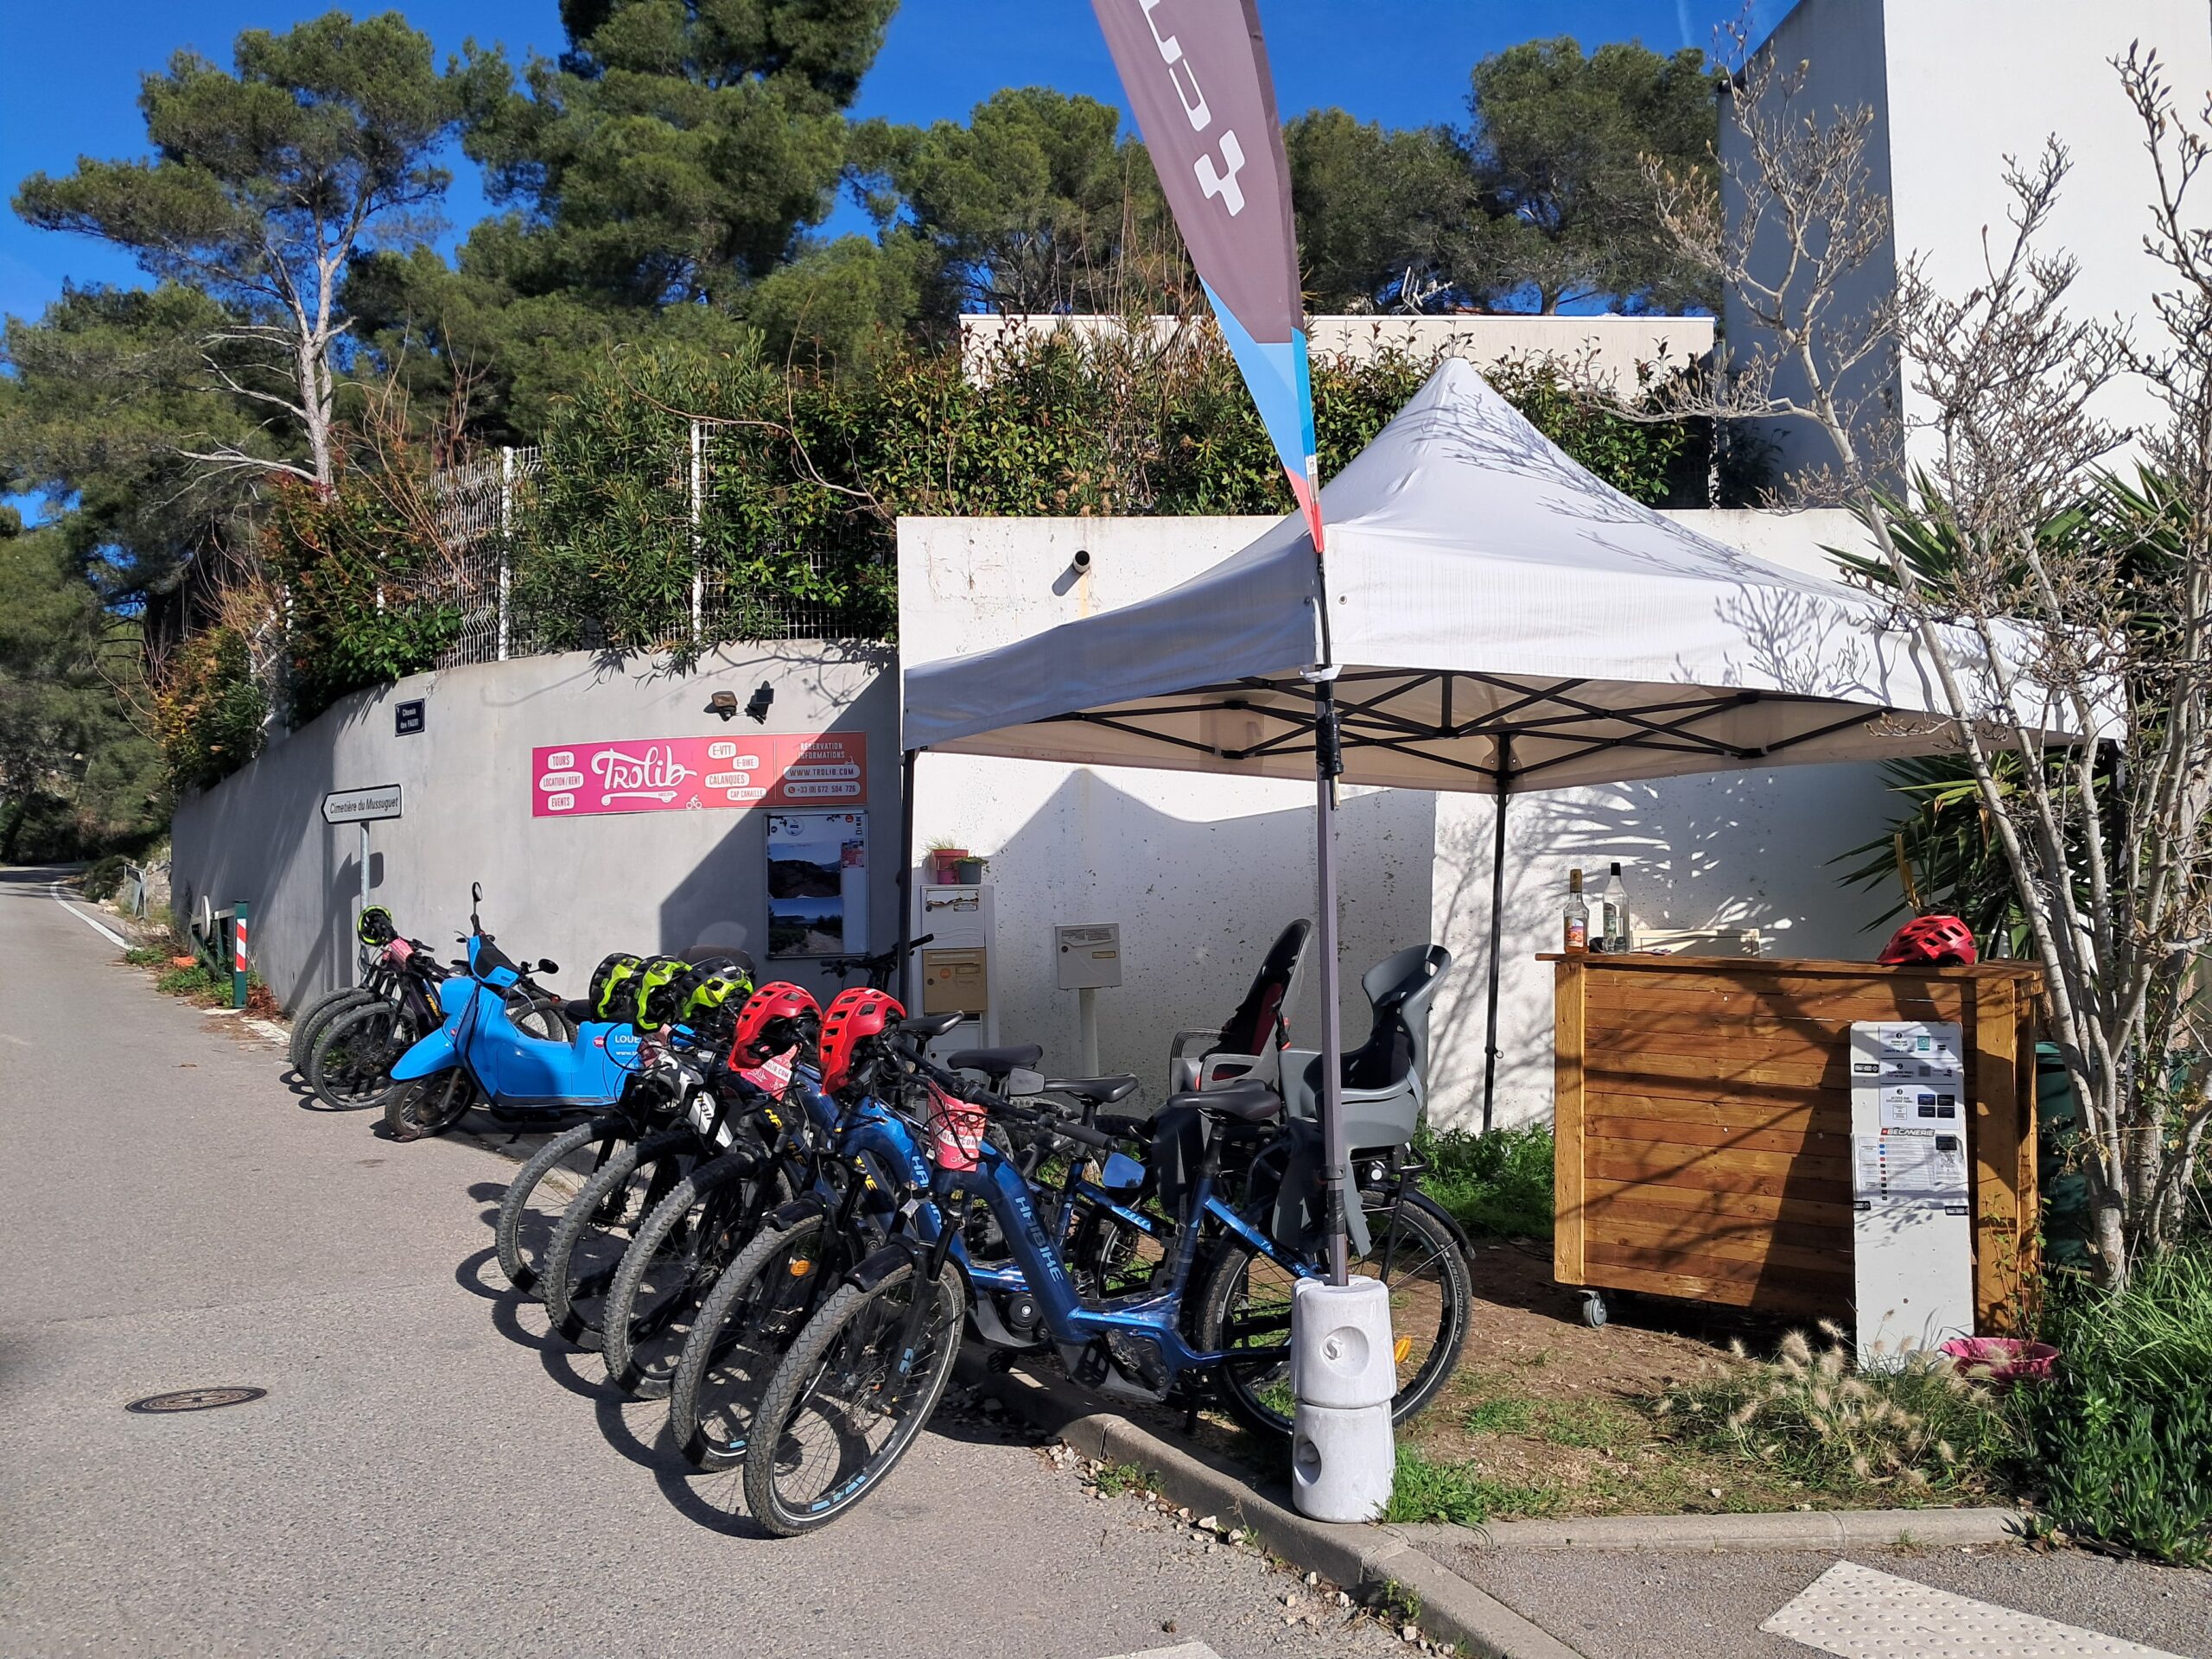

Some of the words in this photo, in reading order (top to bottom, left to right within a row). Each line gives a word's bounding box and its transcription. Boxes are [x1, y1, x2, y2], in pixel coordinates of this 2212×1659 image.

[712, 745, 733, 757] E-VTT
[798, 751, 845, 760] INFORMATIONS
[552, 754, 570, 766] TOURS
[736, 758, 754, 767] E-BIKE
[709, 774, 746, 785] CALANQUES
[730, 790, 741, 798] CAP
[741, 788, 764, 798] CANAILLE
[831, 785, 842, 793] 504
[330, 801, 357, 814] Cimetière
[358, 798, 365, 810] du
[366, 797, 399, 812] Mussuguet
[551, 797, 570, 809] EVENTS
[1014, 1196, 1064, 1283] HAIBIKE
